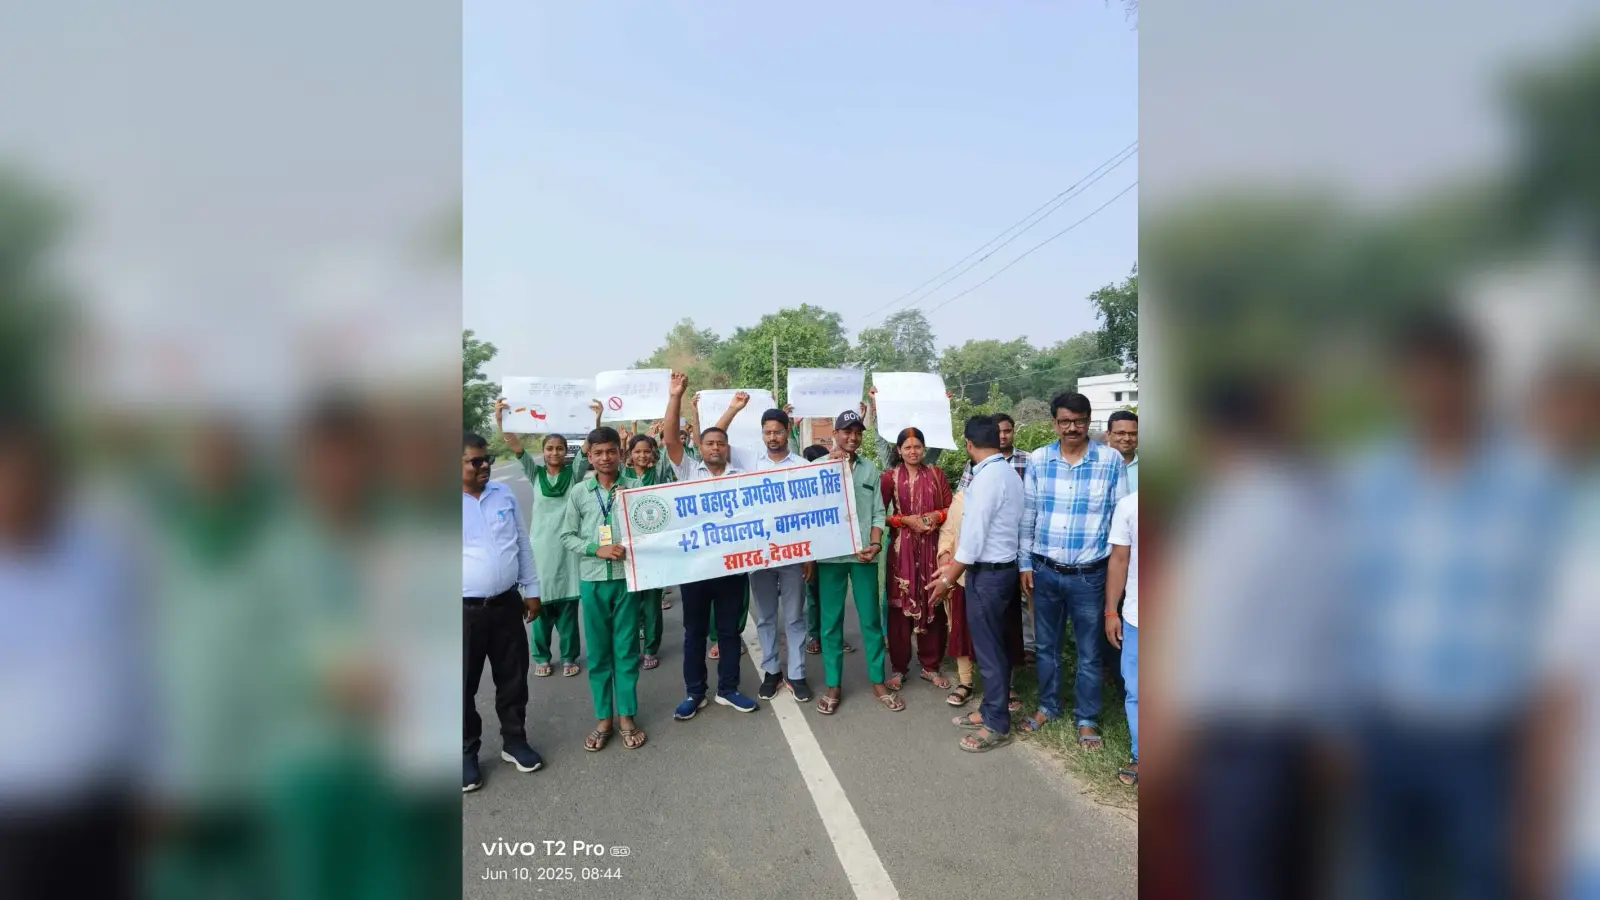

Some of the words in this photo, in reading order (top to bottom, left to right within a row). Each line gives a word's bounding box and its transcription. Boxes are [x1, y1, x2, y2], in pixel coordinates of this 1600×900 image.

[674, 494, 698, 518] राय
[699, 489, 740, 518] बहादुर
[740, 478, 786, 507] जगदीश
[787, 474, 819, 500] प्रसाद
[820, 469, 841, 495] सिंह
[678, 531, 699, 553] +2
[702, 518, 770, 546] विद्यालय,
[774, 507, 840, 534] बामनगामा
